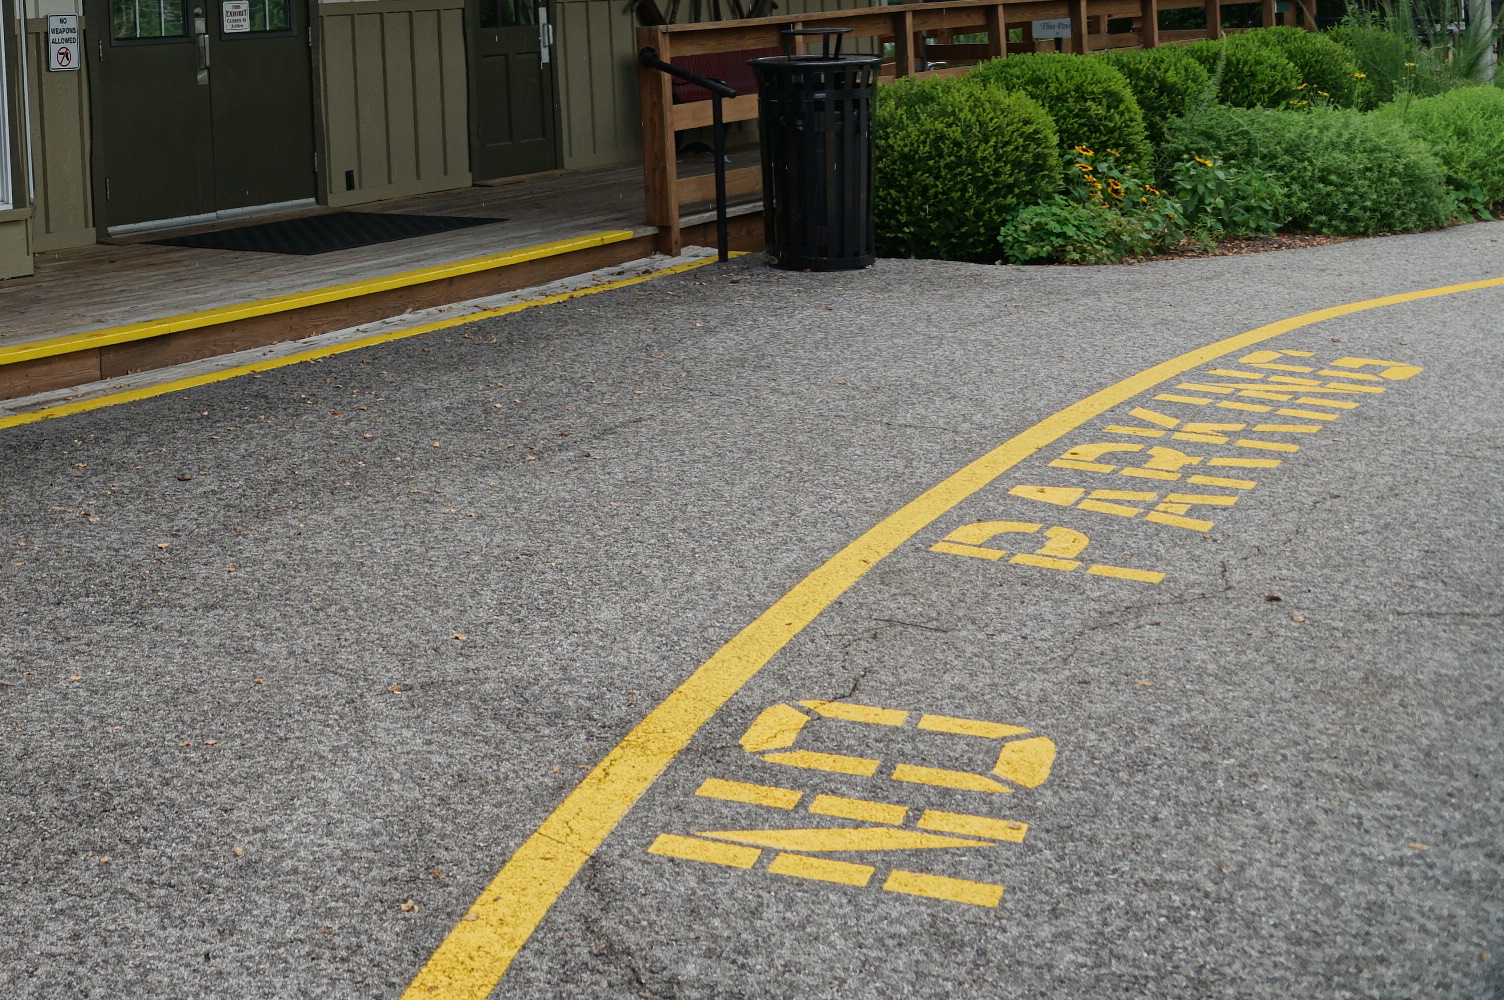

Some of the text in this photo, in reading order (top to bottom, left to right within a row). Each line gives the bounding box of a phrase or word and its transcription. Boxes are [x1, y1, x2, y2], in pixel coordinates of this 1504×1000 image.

[1041, 22, 1056, 30] This
[647, 350, 1424, 908] NO PARKING
